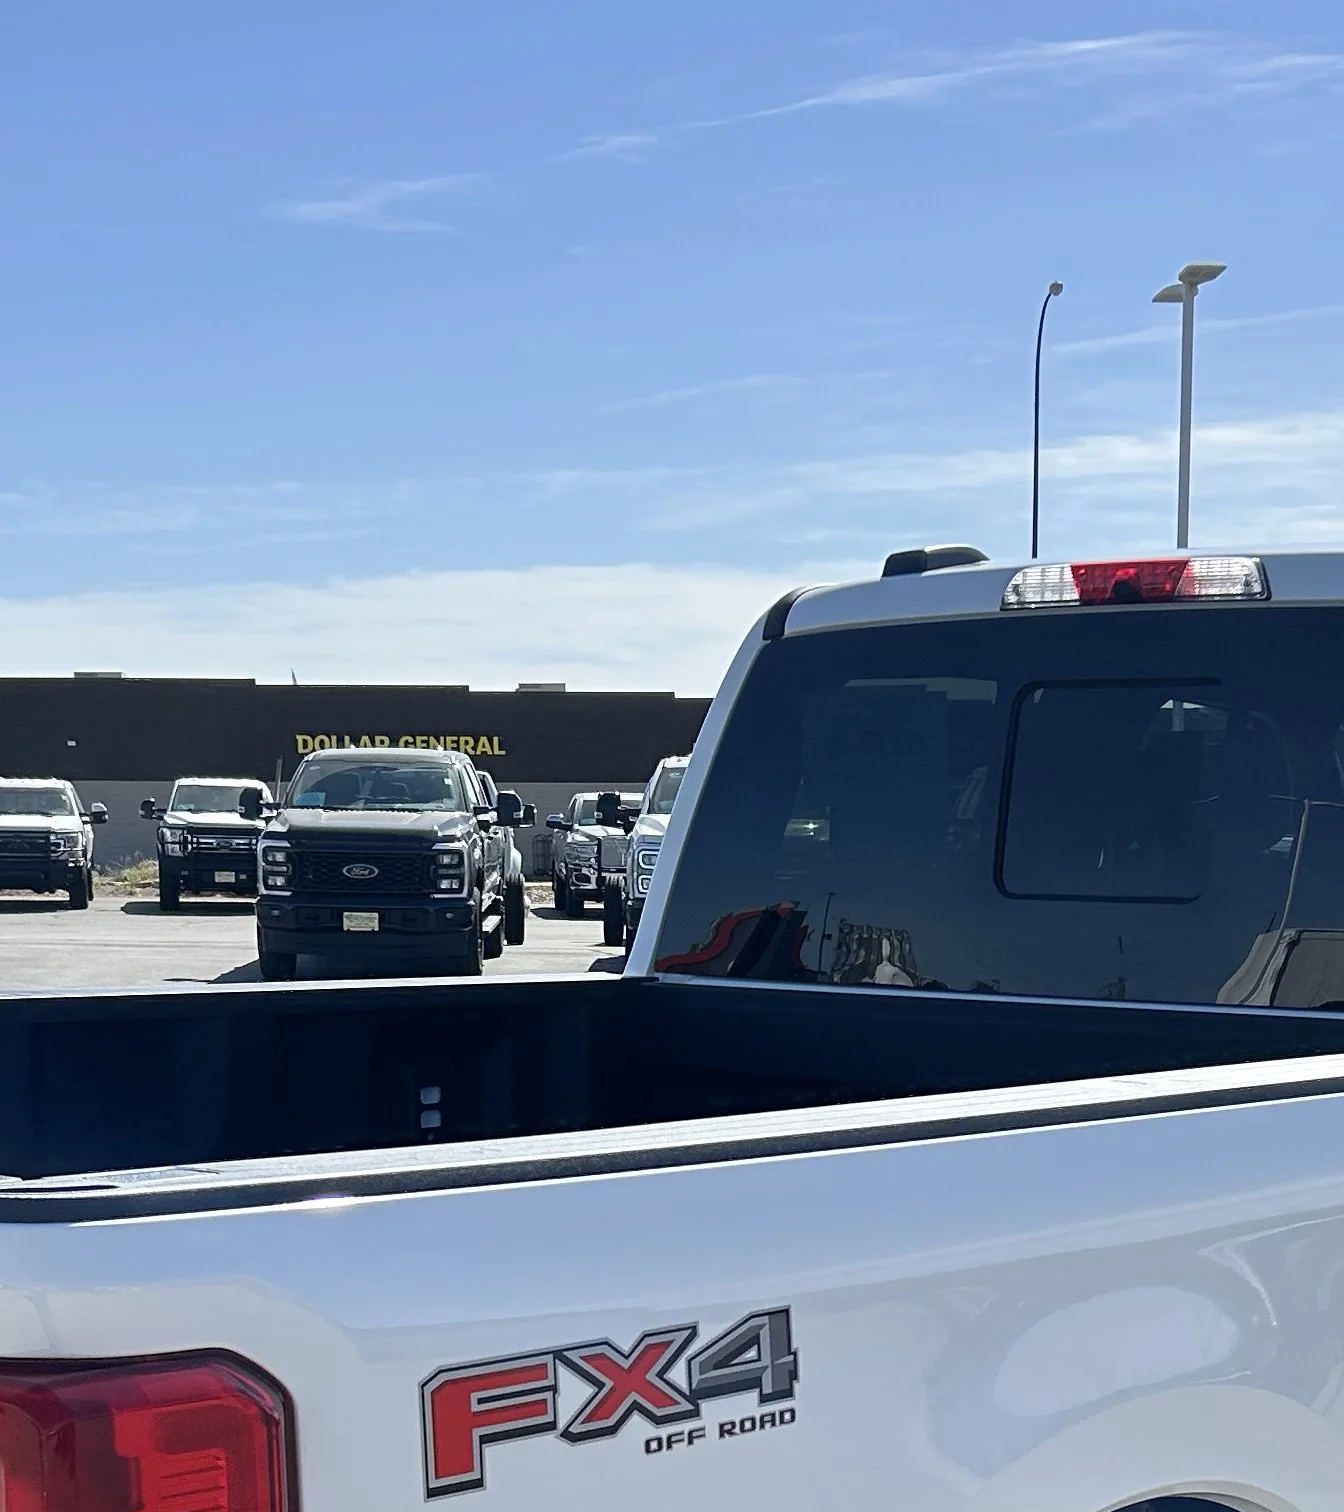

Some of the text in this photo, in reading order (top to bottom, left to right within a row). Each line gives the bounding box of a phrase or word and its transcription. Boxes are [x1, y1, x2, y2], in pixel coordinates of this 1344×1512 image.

[296, 734, 507, 755] DOLLAR GENERAL
[418, 1305, 800, 1503] FX4
[644, 1406, 798, 1456] OFF ROAD
